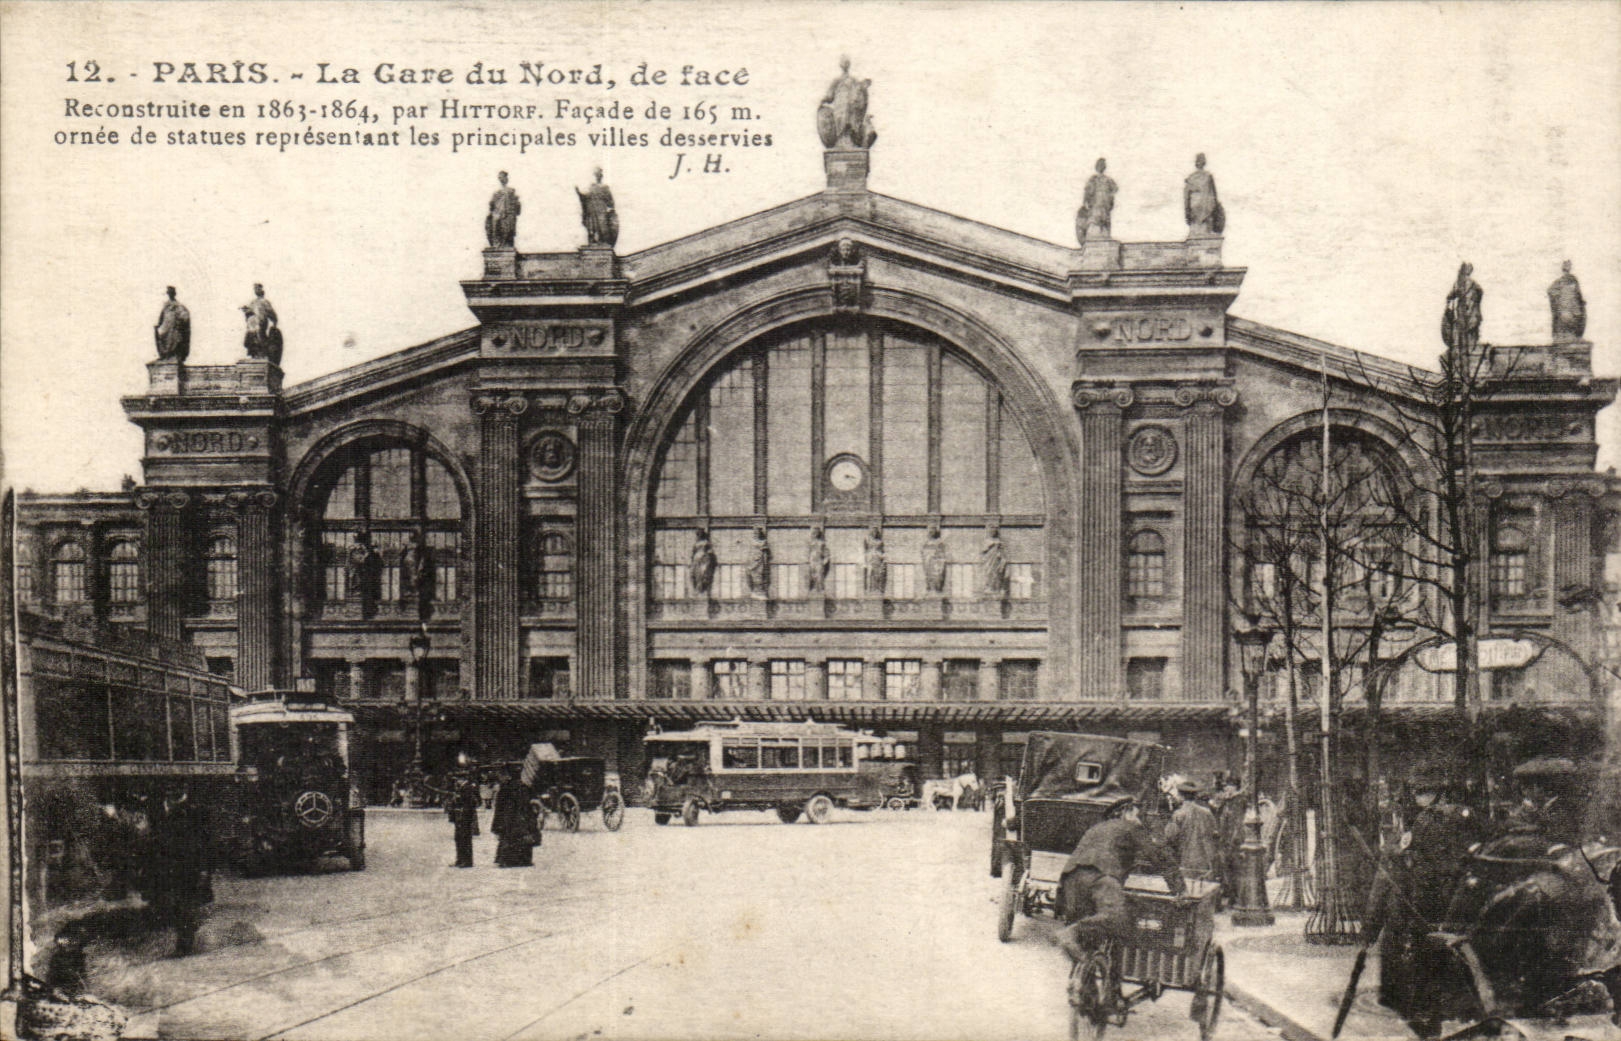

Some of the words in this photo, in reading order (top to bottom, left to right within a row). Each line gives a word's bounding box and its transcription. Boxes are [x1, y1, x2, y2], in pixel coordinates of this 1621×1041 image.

[510, 326, 584, 351] NORD
[1114, 318, 1192, 342] NORD
[170, 431, 243, 453] NORD
